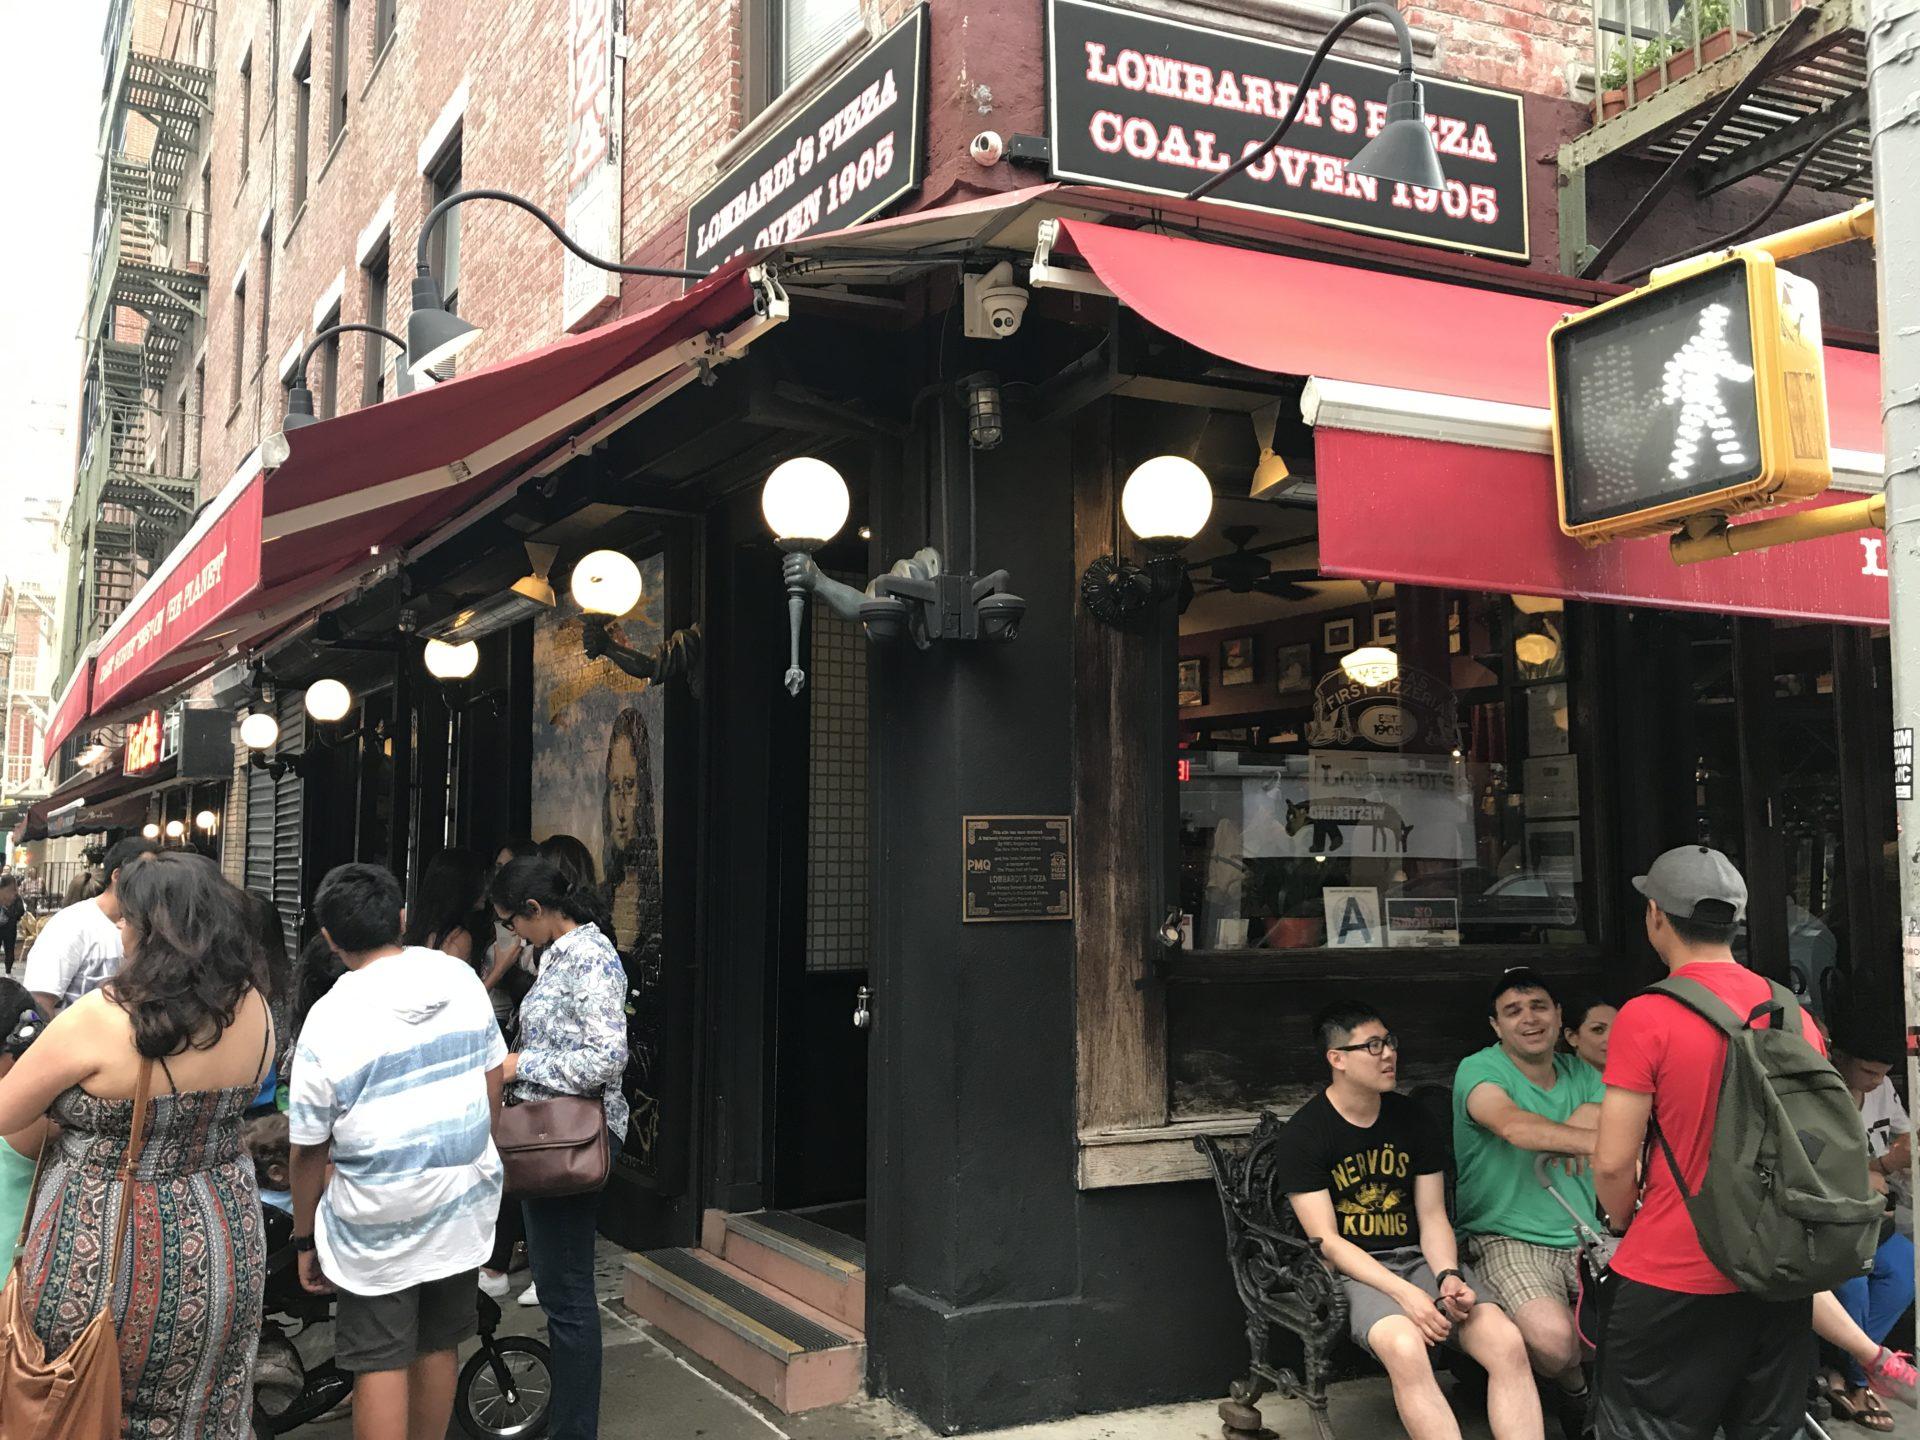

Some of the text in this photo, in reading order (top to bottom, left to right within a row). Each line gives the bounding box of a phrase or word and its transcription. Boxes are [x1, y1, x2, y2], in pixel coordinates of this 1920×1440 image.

[1085, 41, 1497, 163] LOMBARDI'S PZA
[696, 69, 897, 258] LOMBARDI'S PIZZA
[826, 131, 895, 215] 1905
[1089, 110, 1499, 225] COAL OVEN 1905
[1326, 682, 1369, 711] FIRST
[1374, 724, 1404, 736] 1905
[967, 859, 992, 871] PMQ
[1337, 896, 1372, 944] A
[1413, 906, 1432, 921] NO
